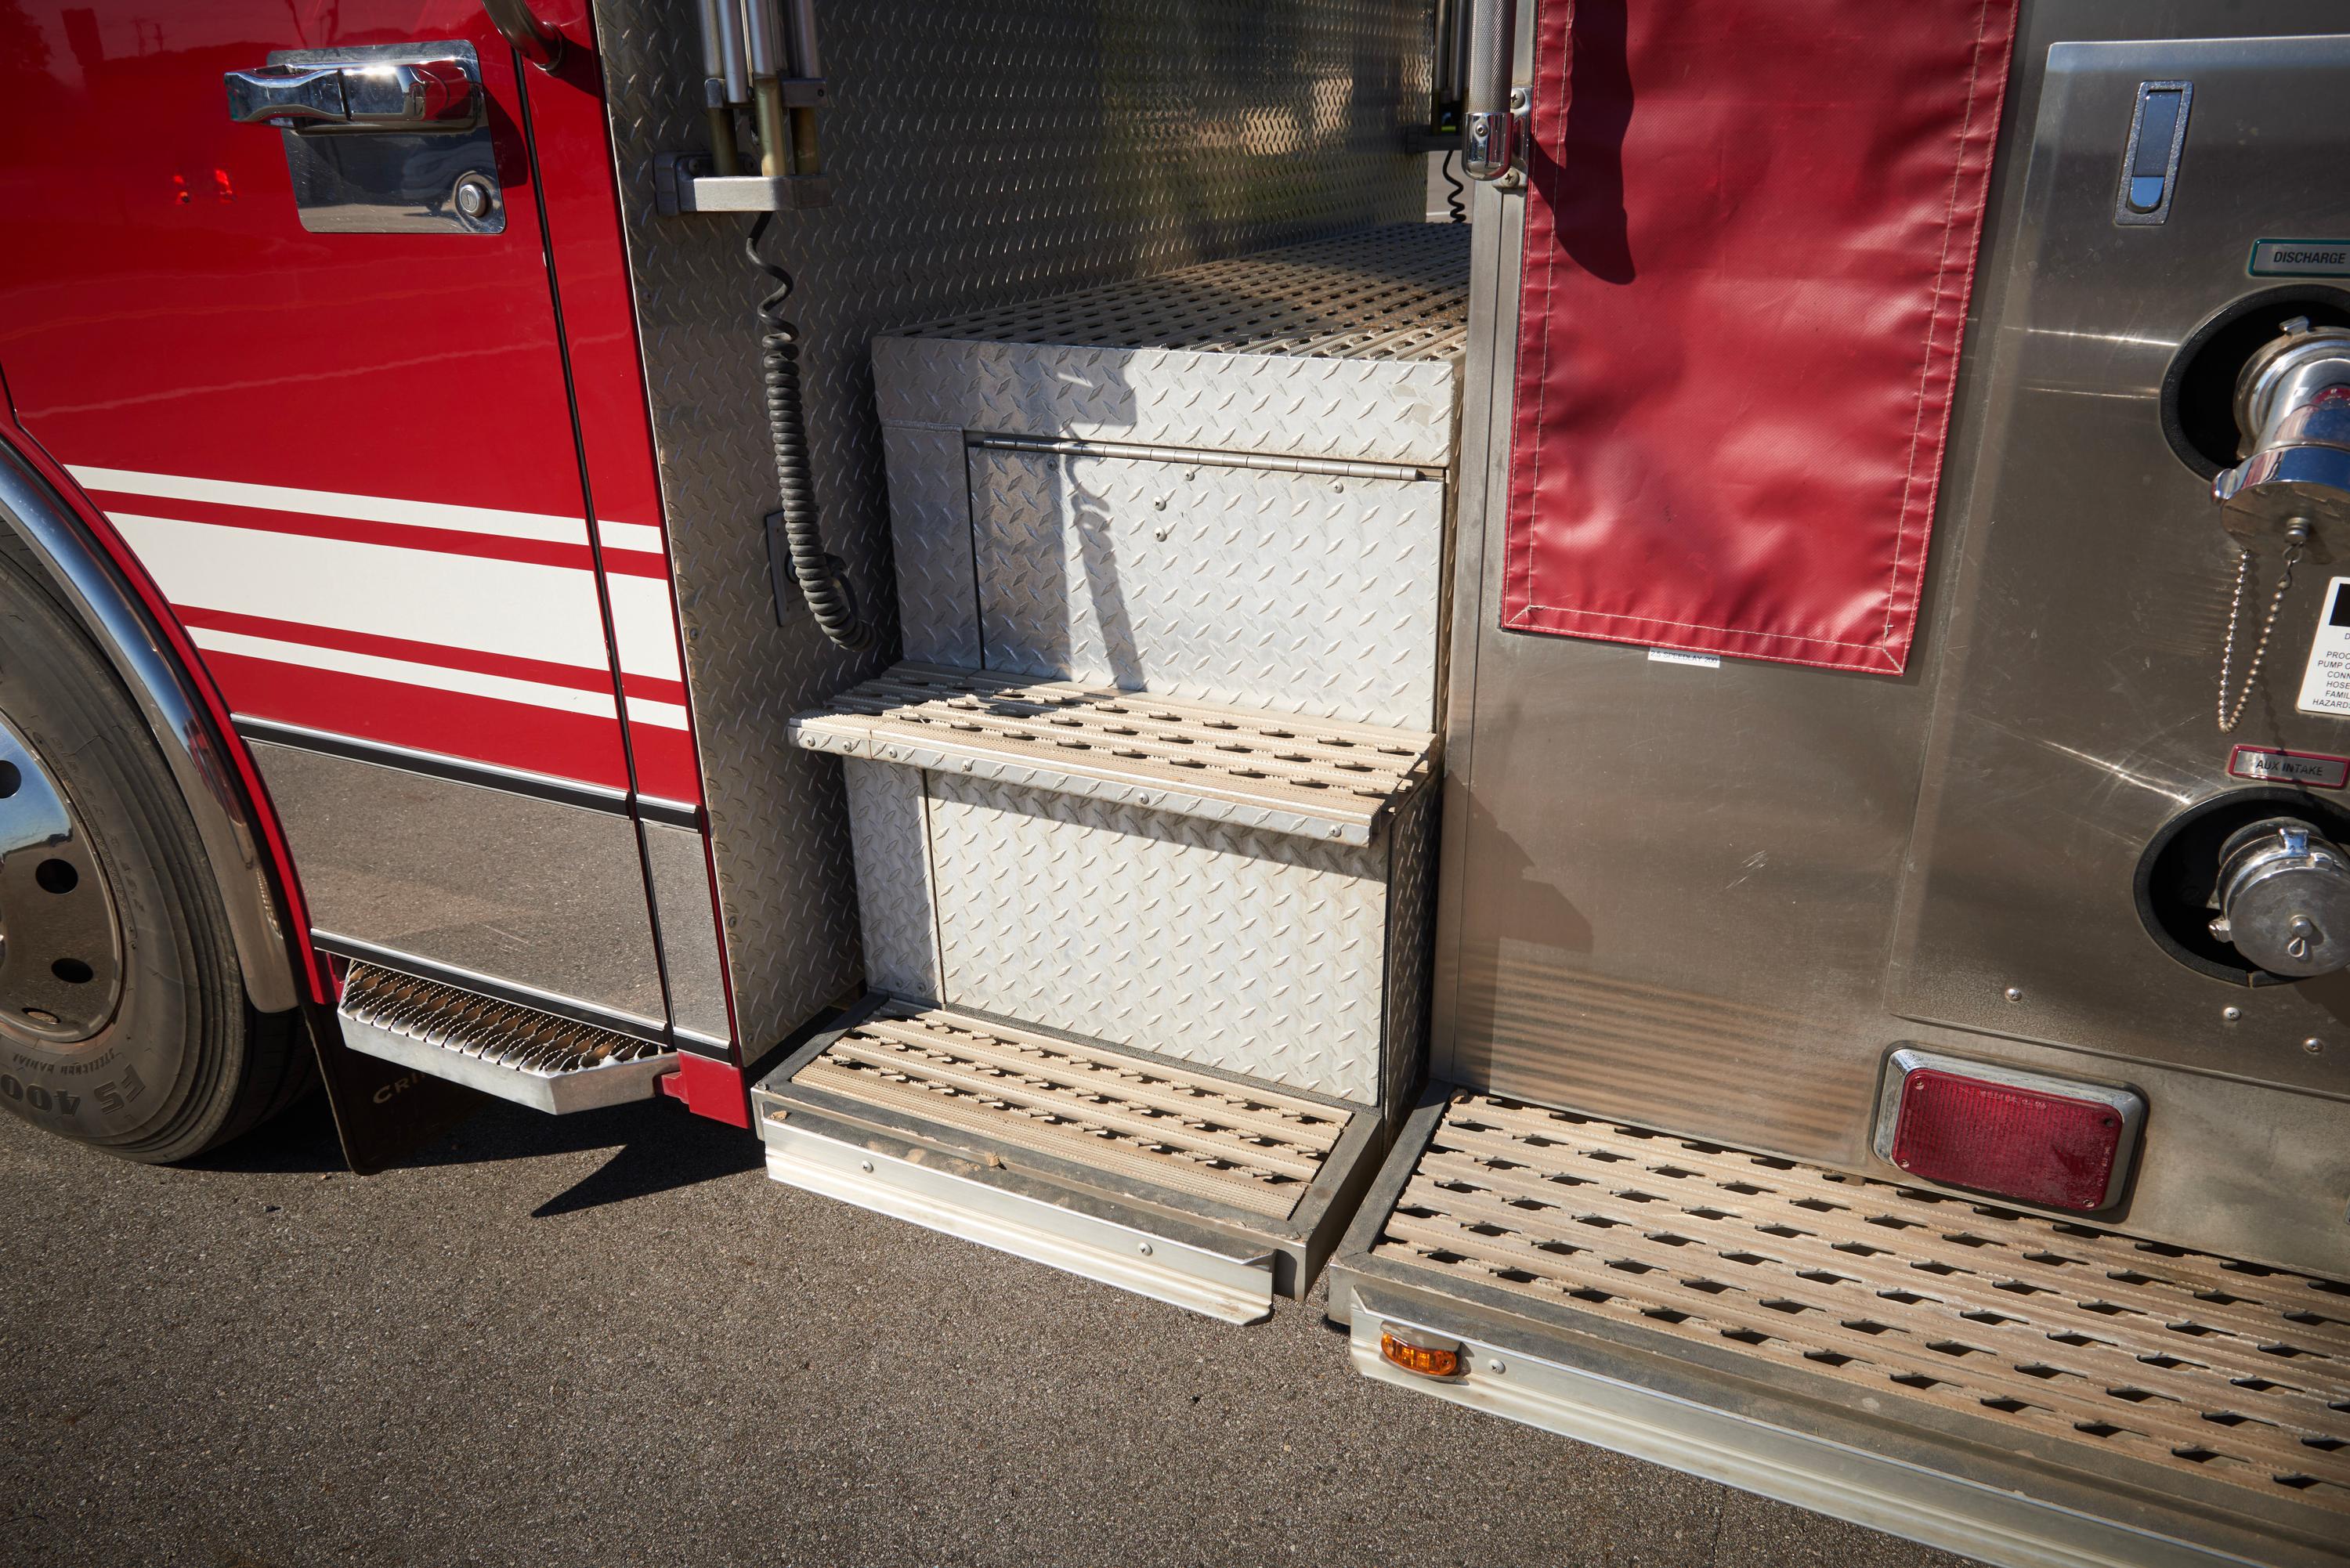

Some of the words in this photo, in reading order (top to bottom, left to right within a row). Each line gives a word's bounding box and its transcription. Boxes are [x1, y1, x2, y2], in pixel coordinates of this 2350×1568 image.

[2274, 251, 2346, 264] DISCHARGE
[2318, 659, 2343, 668] PUMP
[2256, 760, 2280, 771] AUX
[2282, 763, 2323, 776] INTAKE
[1, 1073, 81, 1116] 400
[94, 1063, 146, 1115] FS
